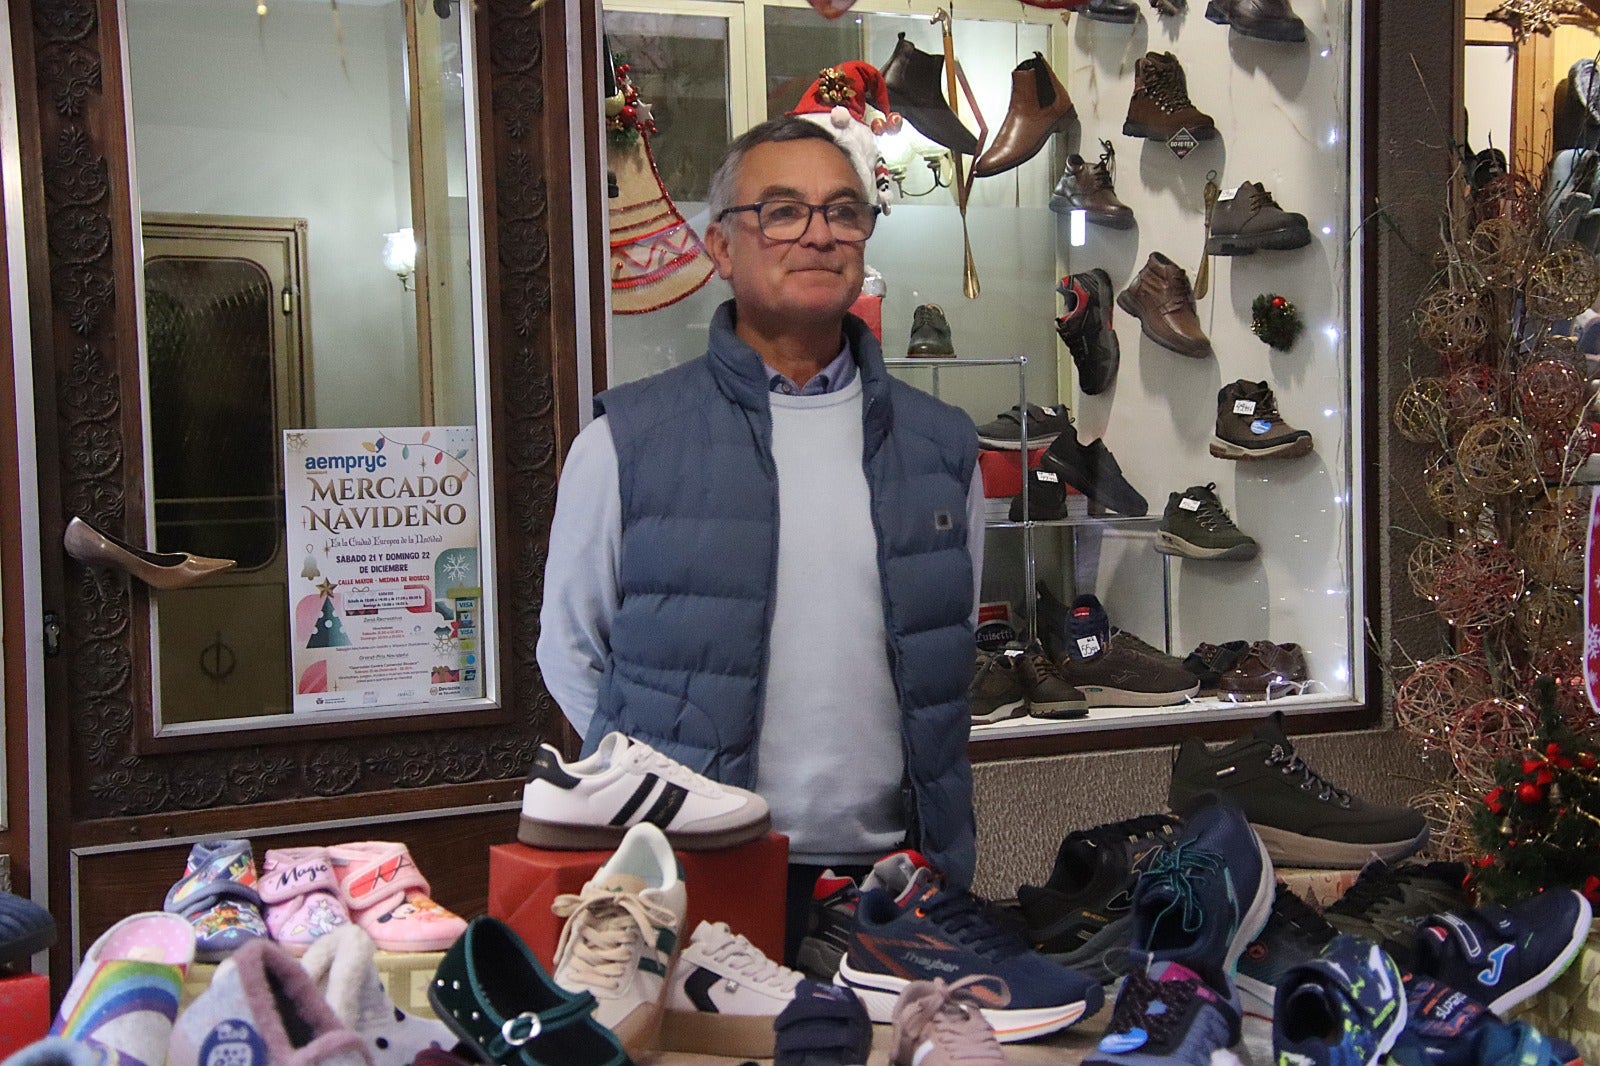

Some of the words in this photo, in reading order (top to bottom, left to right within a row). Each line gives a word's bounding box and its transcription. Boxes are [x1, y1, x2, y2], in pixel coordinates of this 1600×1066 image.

[305, 454, 387, 474] aempryc
[307, 475, 463, 505] MERCADO
[301, 500, 466, 534] NAVIDEÑO
[349, 536, 371, 546] Ciudad
[372, 536, 399, 546] Europea
[415, 534, 442, 544] Navidad
[386, 552, 419, 560] DOMINGO
[371, 564, 408, 573] DICIEMBRE
[276, 865, 328, 890] Magic
